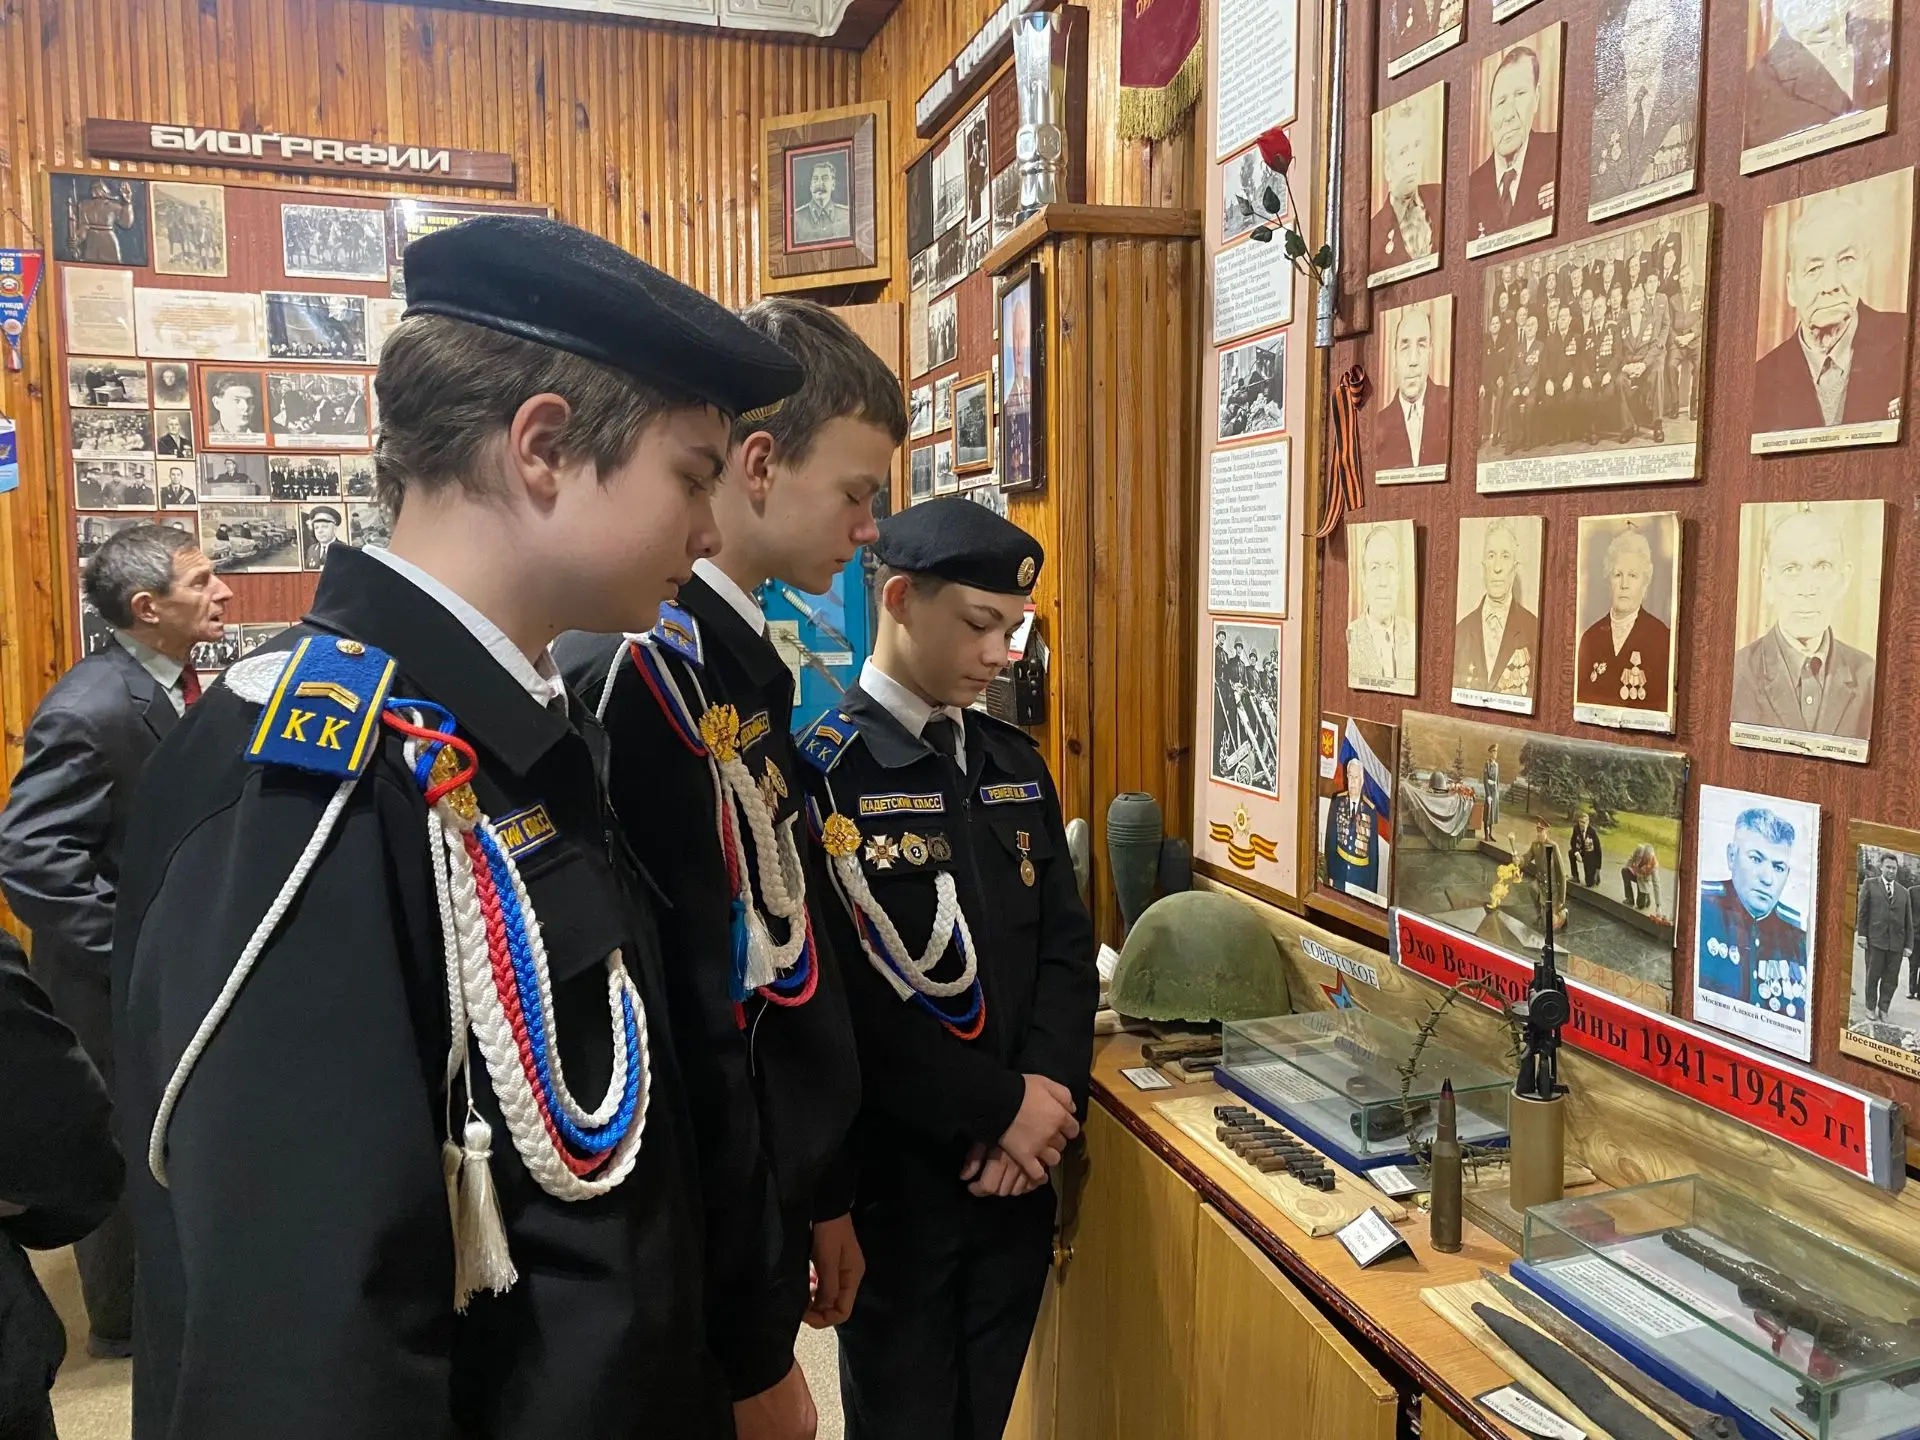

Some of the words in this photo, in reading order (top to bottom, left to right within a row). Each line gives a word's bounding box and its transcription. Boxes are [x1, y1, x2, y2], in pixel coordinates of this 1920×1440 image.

[150, 125, 450, 173] БИОГРАФИИ
[861, 797, 912, 813] КАДЕТСКИЙ
[914, 796, 941, 810] КЛАСС
[912, 847, 922, 858] 2
[1302, 939, 1379, 987] СОВЕТСКОЕ
[1701, 994, 1731, 1011] Москвин
[1731, 1004, 1760, 1021] Алексей
[1760, 1014, 1802, 1035] Степанович
[1401, 926, 1436, 965] Эхо
[1640, 1026, 1809, 1128] 1941-1945
[1823, 1113, 1860, 1154] гг.
[1845, 1031, 1902, 1059] Посещение
